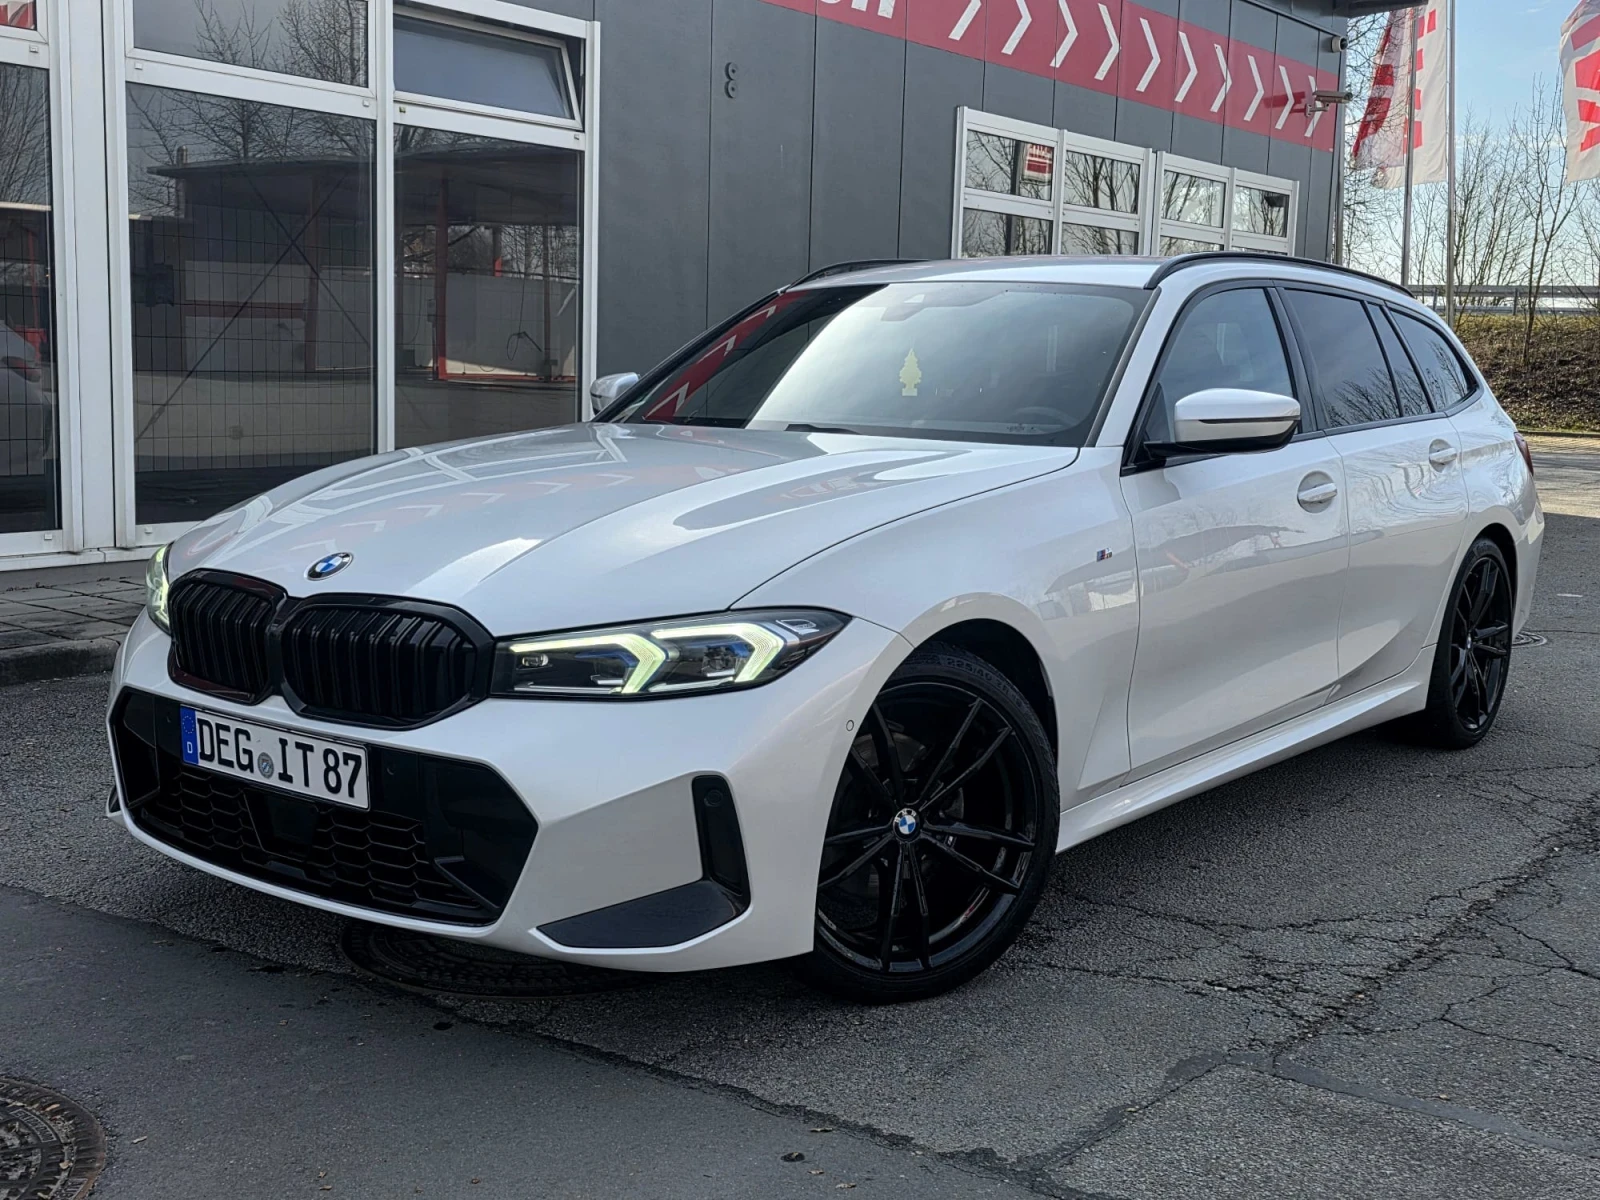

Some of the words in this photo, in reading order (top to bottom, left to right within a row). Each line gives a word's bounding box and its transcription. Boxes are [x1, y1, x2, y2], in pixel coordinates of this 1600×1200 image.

[186, 741, 194, 754] D
[197, 717, 255, 774] DEG
[278, 737, 315, 788] IT
[322, 748, 362, 799] 87
